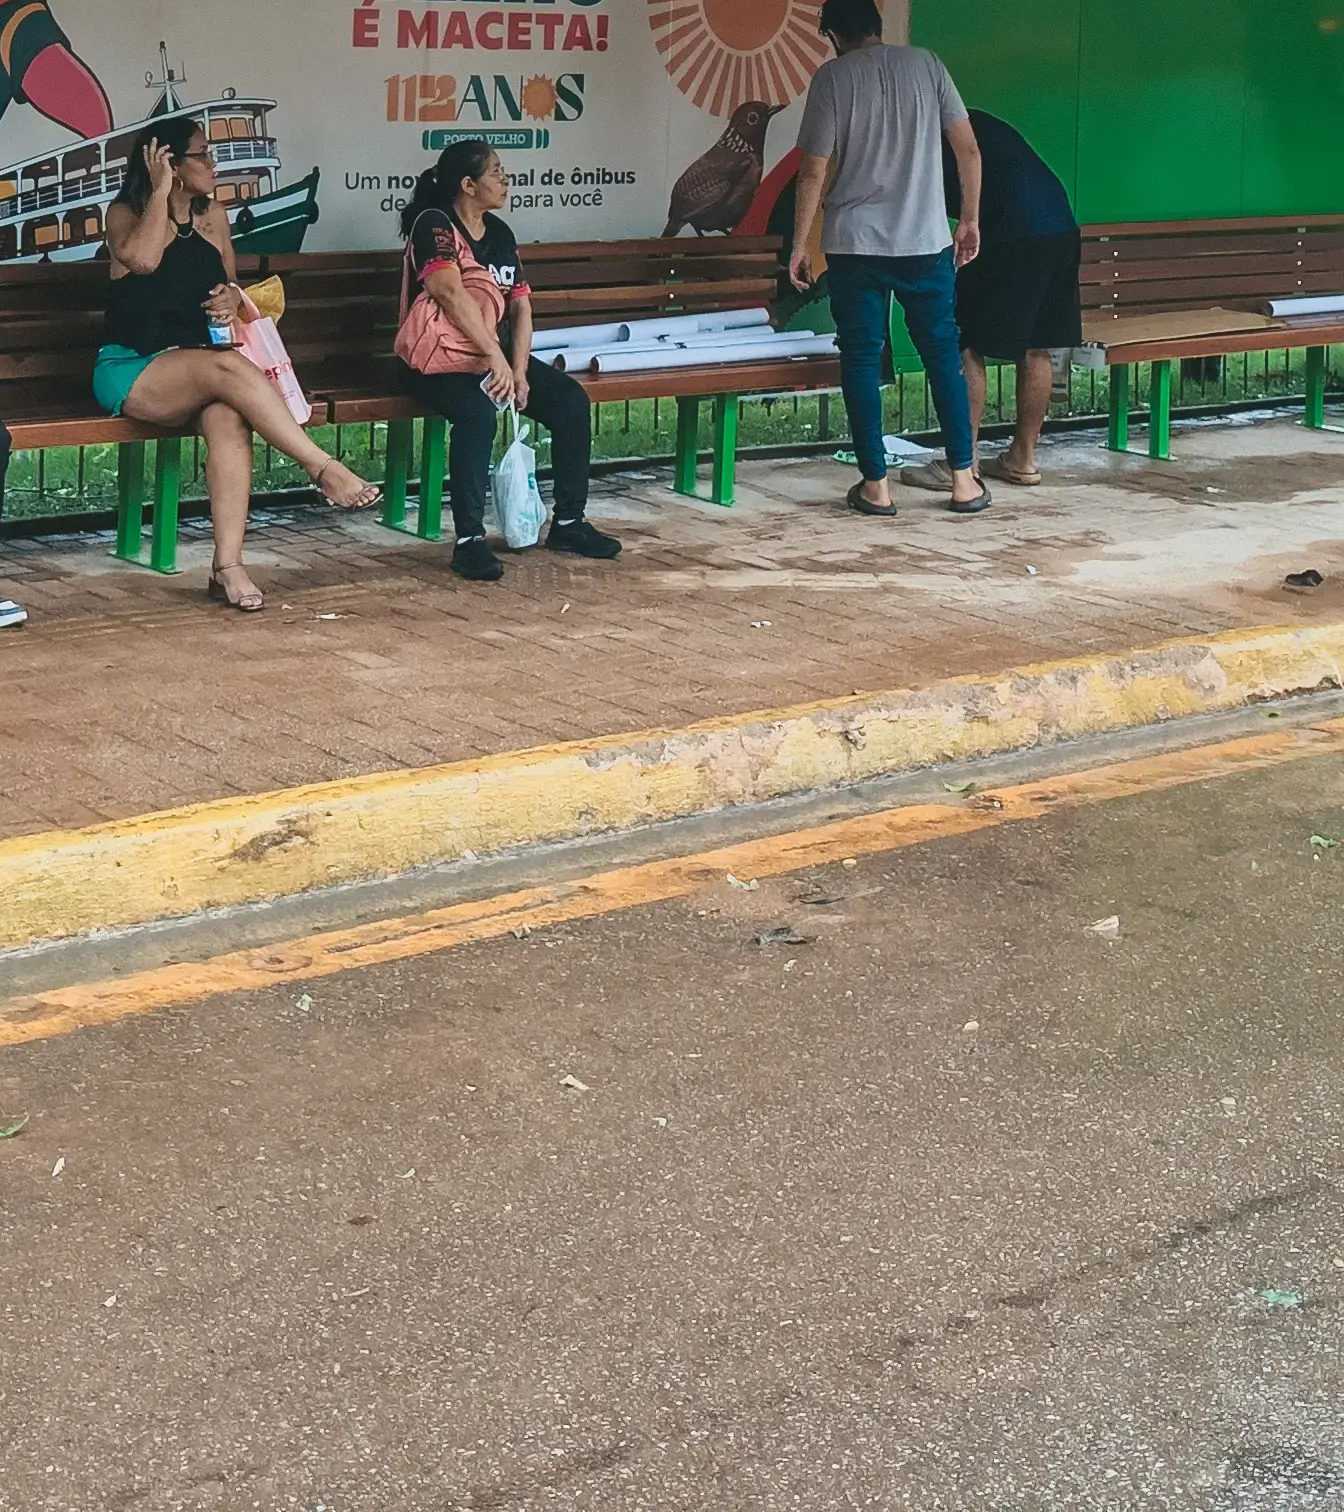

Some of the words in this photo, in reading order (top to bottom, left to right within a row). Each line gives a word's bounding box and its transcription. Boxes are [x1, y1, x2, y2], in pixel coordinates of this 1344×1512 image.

[397, 10, 609, 52] MACETA!
[486, 133, 526, 145] VELHO
[345, 172, 381, 190] Um
[540, 168, 565, 186] de
[570, 166, 636, 186] ônibus
[510, 193, 554, 213] para
[559, 188, 603, 207] você
